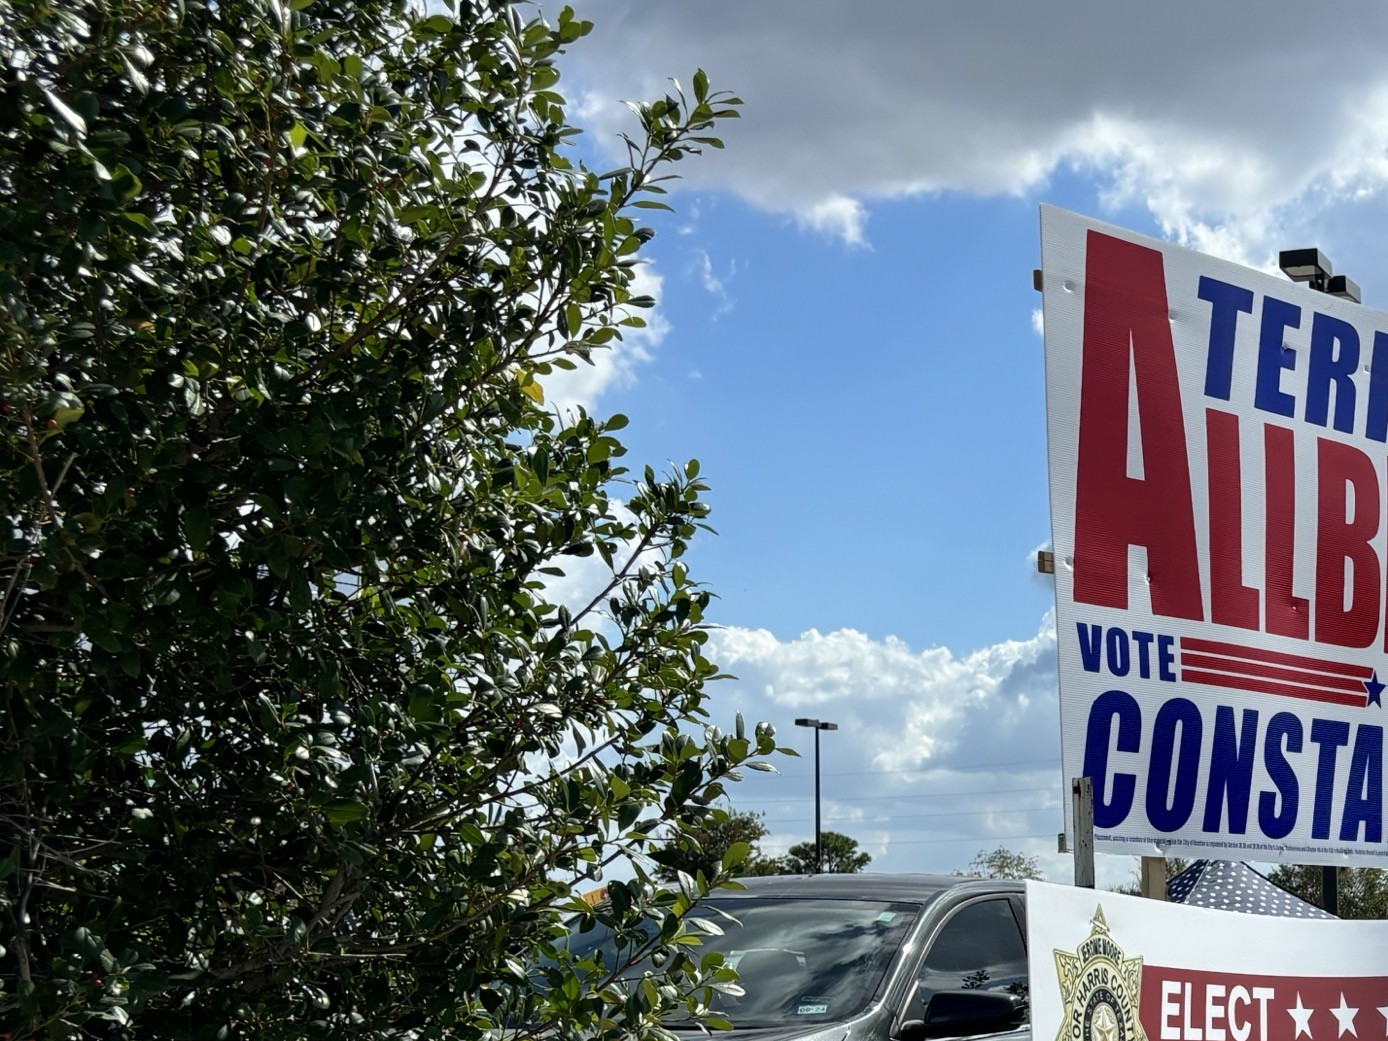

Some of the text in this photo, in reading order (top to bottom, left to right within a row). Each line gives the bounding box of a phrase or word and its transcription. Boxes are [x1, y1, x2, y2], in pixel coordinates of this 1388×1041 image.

[1076, 622, 1177, 683] VOTE
[1102, 938, 1121, 963] MOORE
[1076, 967, 1109, 1008] HARRIS
